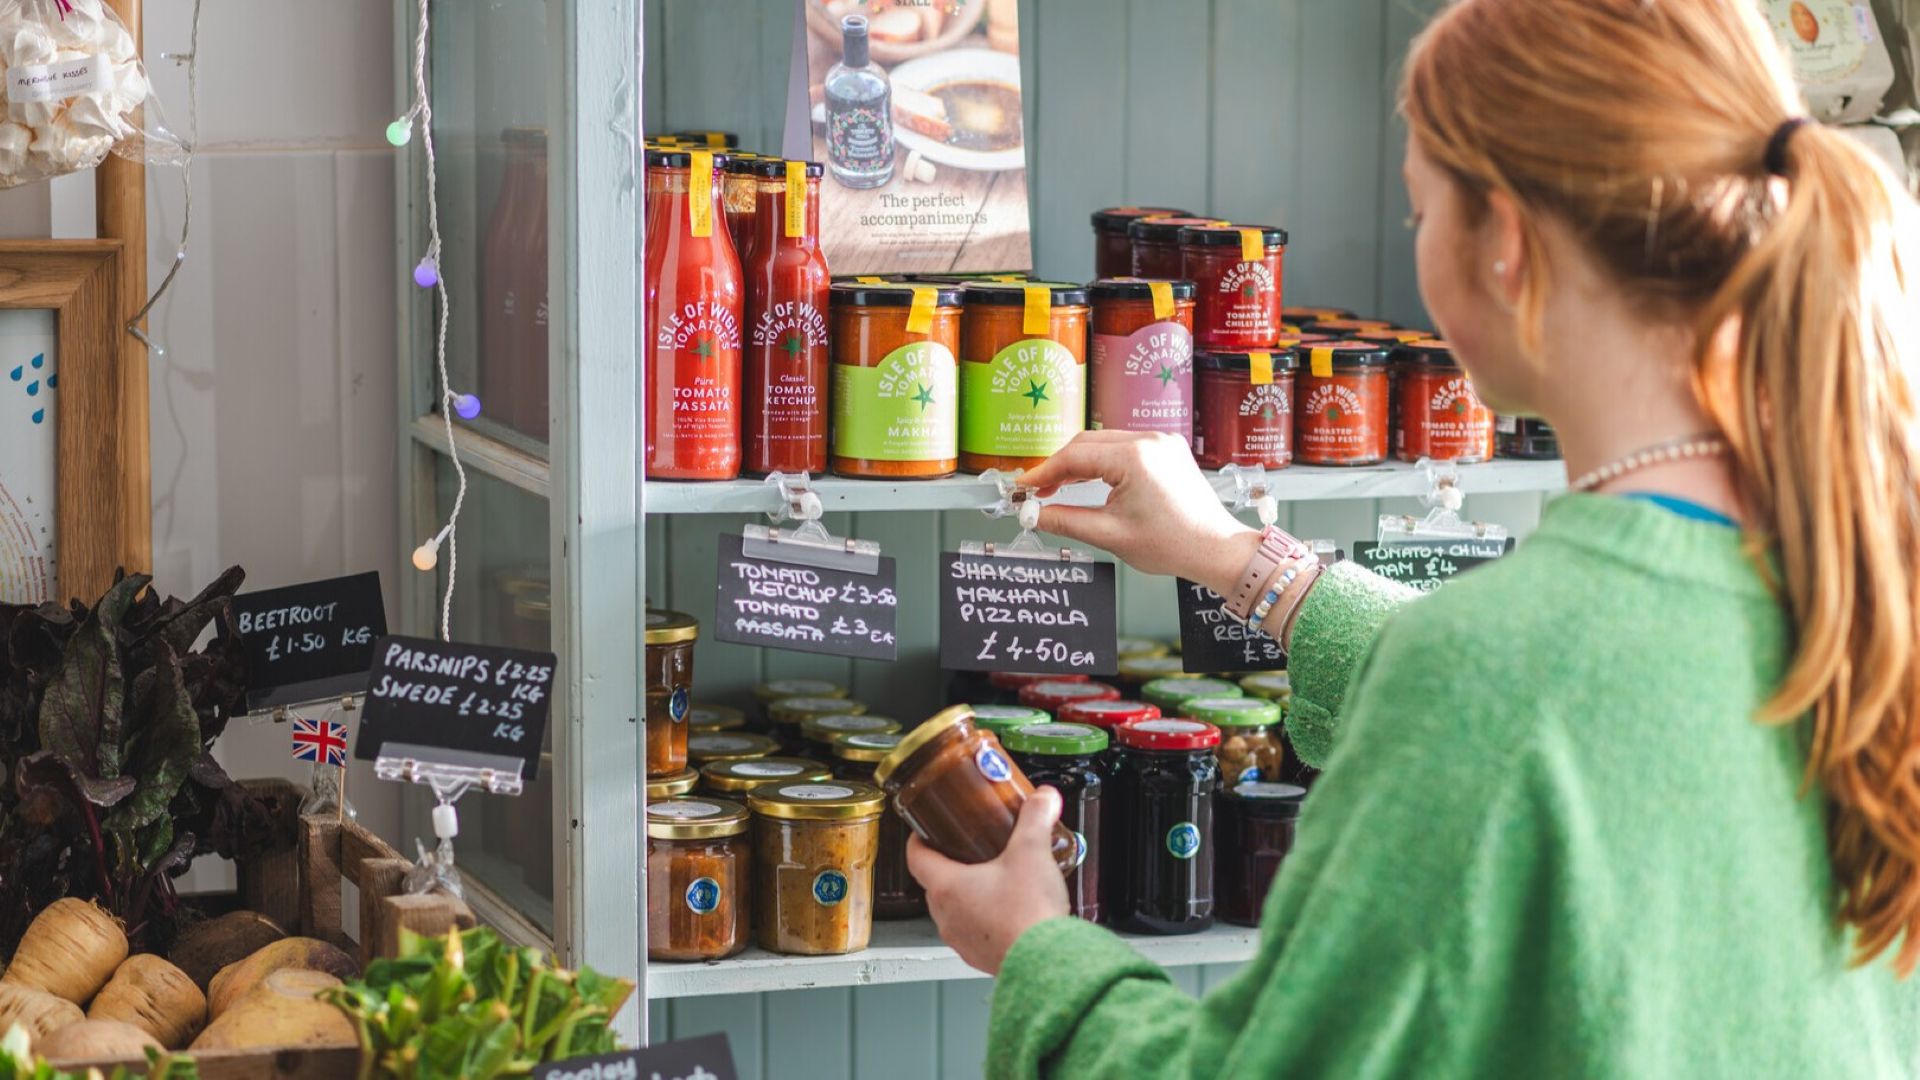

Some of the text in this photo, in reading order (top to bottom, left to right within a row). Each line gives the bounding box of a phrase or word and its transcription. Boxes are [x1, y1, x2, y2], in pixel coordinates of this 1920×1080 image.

[62, 66, 88, 79] KISSES
[880, 192, 966, 211] The perfect
[860, 211, 988, 229] accompaniments
[1220, 269, 1237, 293] ISLE
[1237, 262, 1250, 273] OF
[658, 302, 740, 350] ISLE OF WIGHT
[753, 302, 829, 346] ISLE OF WIGHT
[766, 319, 818, 347] TOMATOES
[674, 320, 730, 350] TOMATOES
[1125, 343, 1149, 375] ISLE
[1150, 333, 1168, 348] OF
[1140, 348, 1186, 376] TOMATOES
[780, 374, 806, 382] Classic
[878, 360, 904, 398] ISLE
[906, 349, 925, 366] OF
[991, 358, 1016, 393] ISLE
[1018, 346, 1038, 363] OF
[694, 376, 714, 386] Pure
[768, 385, 815, 394] TOMATO
[1320, 384, 1333, 395] OF
[1448, 379, 1460, 391] OF
[673, 387, 730, 398] TOMATO
[767, 396, 817, 405] KETCHUP
[1239, 392, 1256, 416] ISLE
[1256, 384, 1269, 396] OF
[673, 401, 730, 411] PASSATA
[1132, 408, 1188, 417] ROMESCO
[1365, 548, 1432, 560] TOMATO
[1449, 544, 1502, 557] CHILLI
[730, 562, 820, 585] TOMATO
[951, 562, 1088, 584] SHAKSHUKA
[1374, 562, 1413, 577] JAM
[748, 580, 838, 604] KETCHUP
[956, 586, 1070, 607] MAKHANI
[239, 601, 338, 633] BEETROOT
[734, 599, 820, 620] TOMATO
[960, 603, 1089, 627] PIZZAIOLA
[341, 627, 371, 646] KG
[735, 618, 825, 642] PASSATA
[384, 643, 490, 684] PARSNIPS
[372, 675, 458, 706] SWEDE
[511, 684, 545, 703] KG
[492, 723, 525, 742] KG
